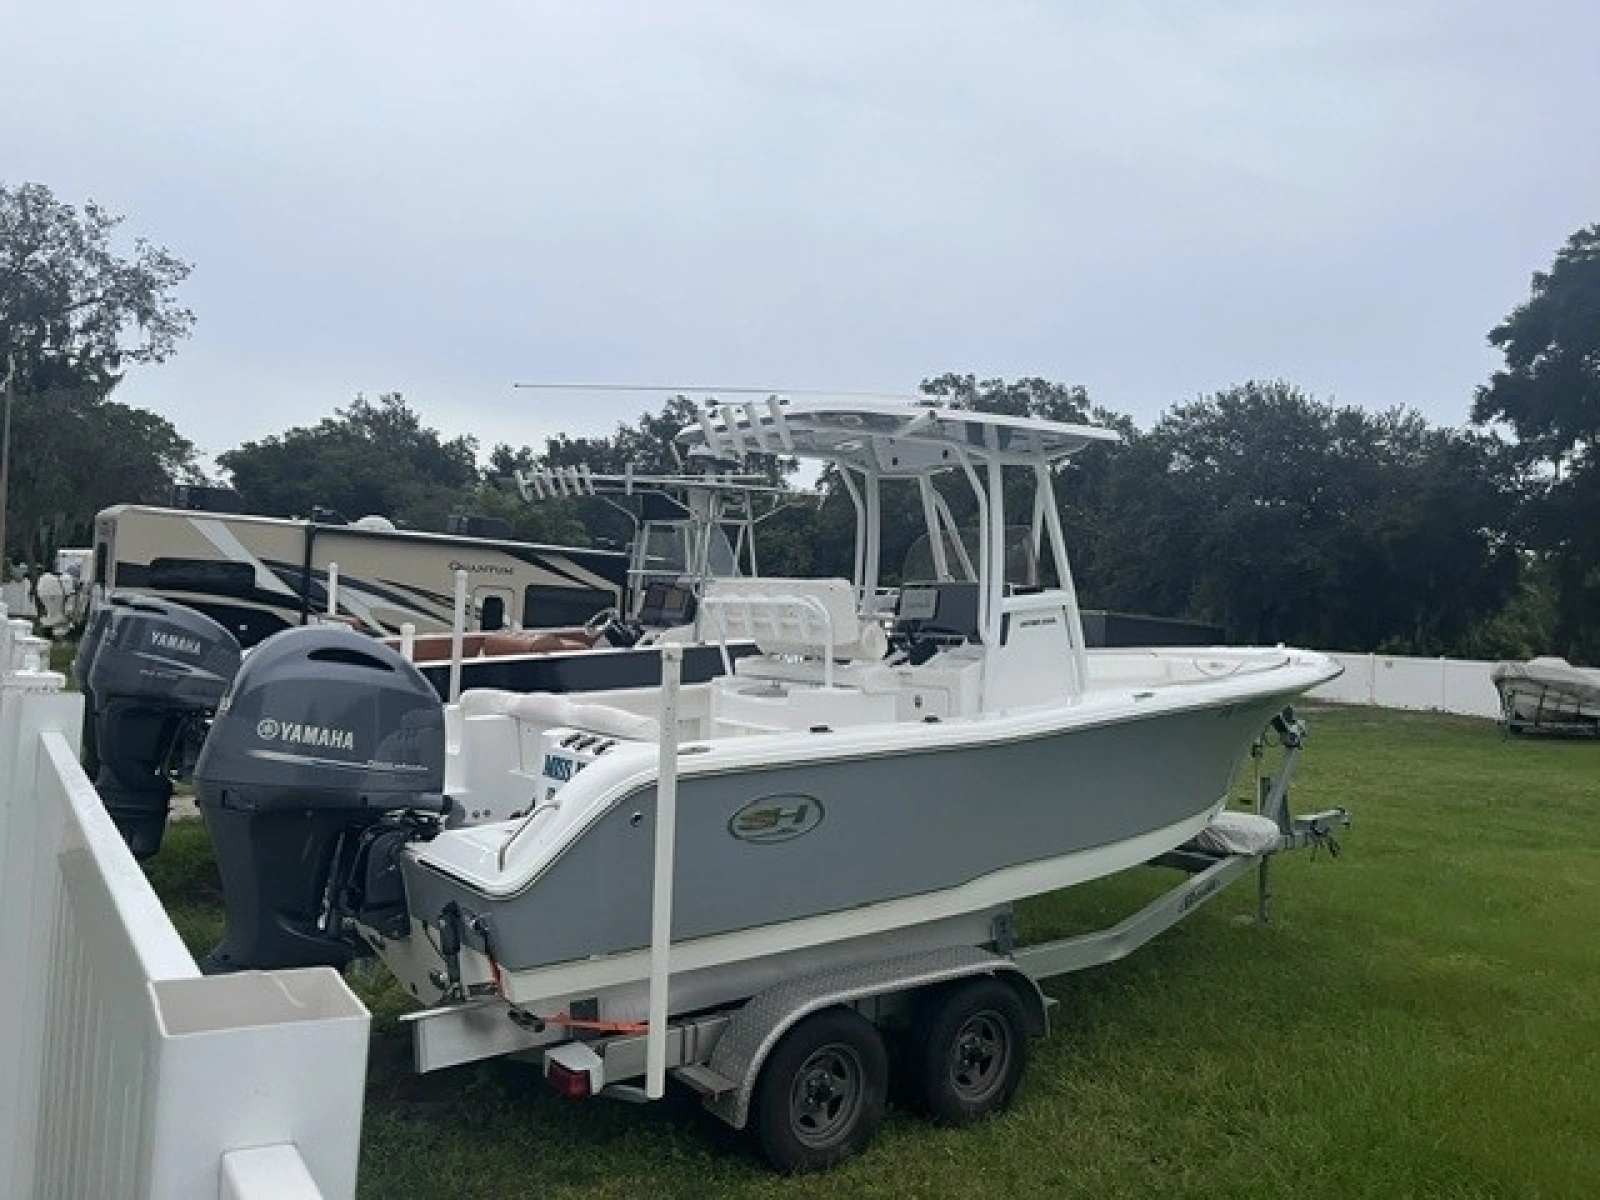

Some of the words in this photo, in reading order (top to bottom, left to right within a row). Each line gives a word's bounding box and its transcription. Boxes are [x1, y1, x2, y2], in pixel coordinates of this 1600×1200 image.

[447, 560, 514, 576] QUANTUM
[151, 631, 201, 655] YAMAHA
[281, 722, 354, 750] YAMAHA
[543, 755, 573, 782] MISS
